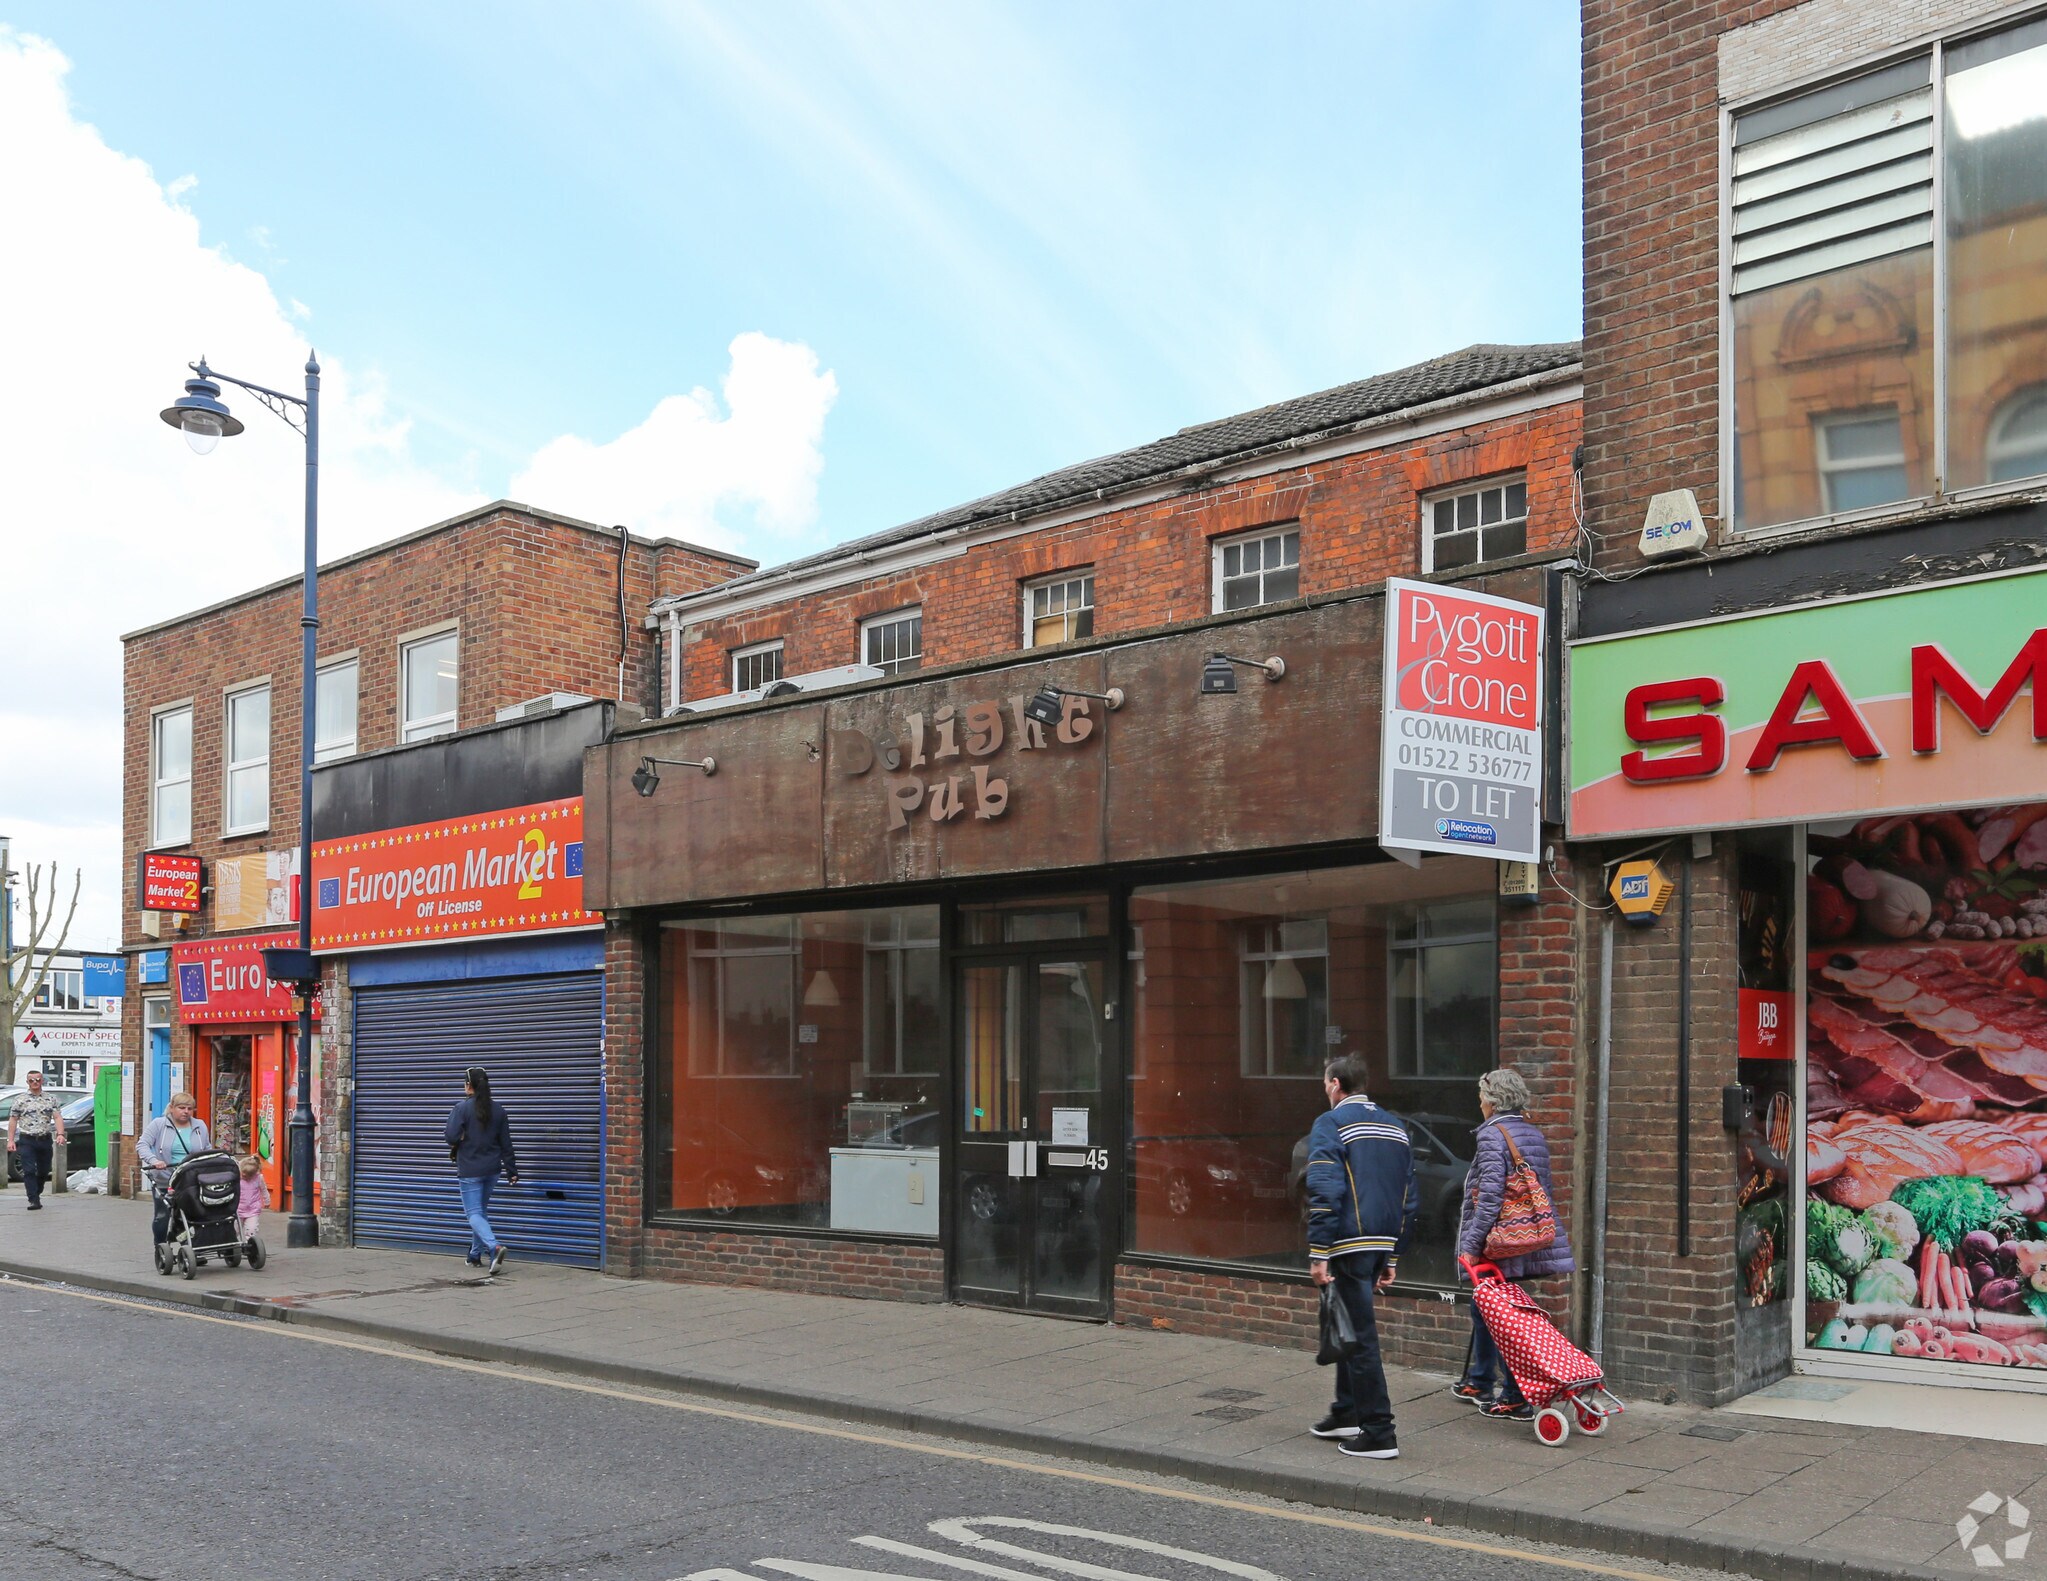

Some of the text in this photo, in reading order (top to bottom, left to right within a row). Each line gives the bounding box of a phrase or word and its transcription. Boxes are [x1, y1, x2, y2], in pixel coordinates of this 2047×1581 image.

[1645, 519, 1692, 540] SECOM
[1410, 595, 1528, 665] Pygott
[1420, 659, 1527, 719] Crone
[1400, 716, 1533, 756] COMMERCIAL
[1398, 743, 1532, 782] 01522 536777
[1416, 776, 1516, 820] TO LET
[1450, 821, 1493, 836] Relocation
[147, 865, 198, 881] European
[345, 827, 559, 910] European Market 2
[147, 884, 185, 898] Market
[184, 880, 198, 900] 2
[1621, 880, 1649, 895] ADT
[416, 899, 483, 919] Off License
[86, 960, 109, 970] Bupa
[1757, 1002, 1778, 1030] JBB
[41, 1031, 120, 1040] ACCIDENT SPEC
[1086, 1149, 1109, 1171] 45
